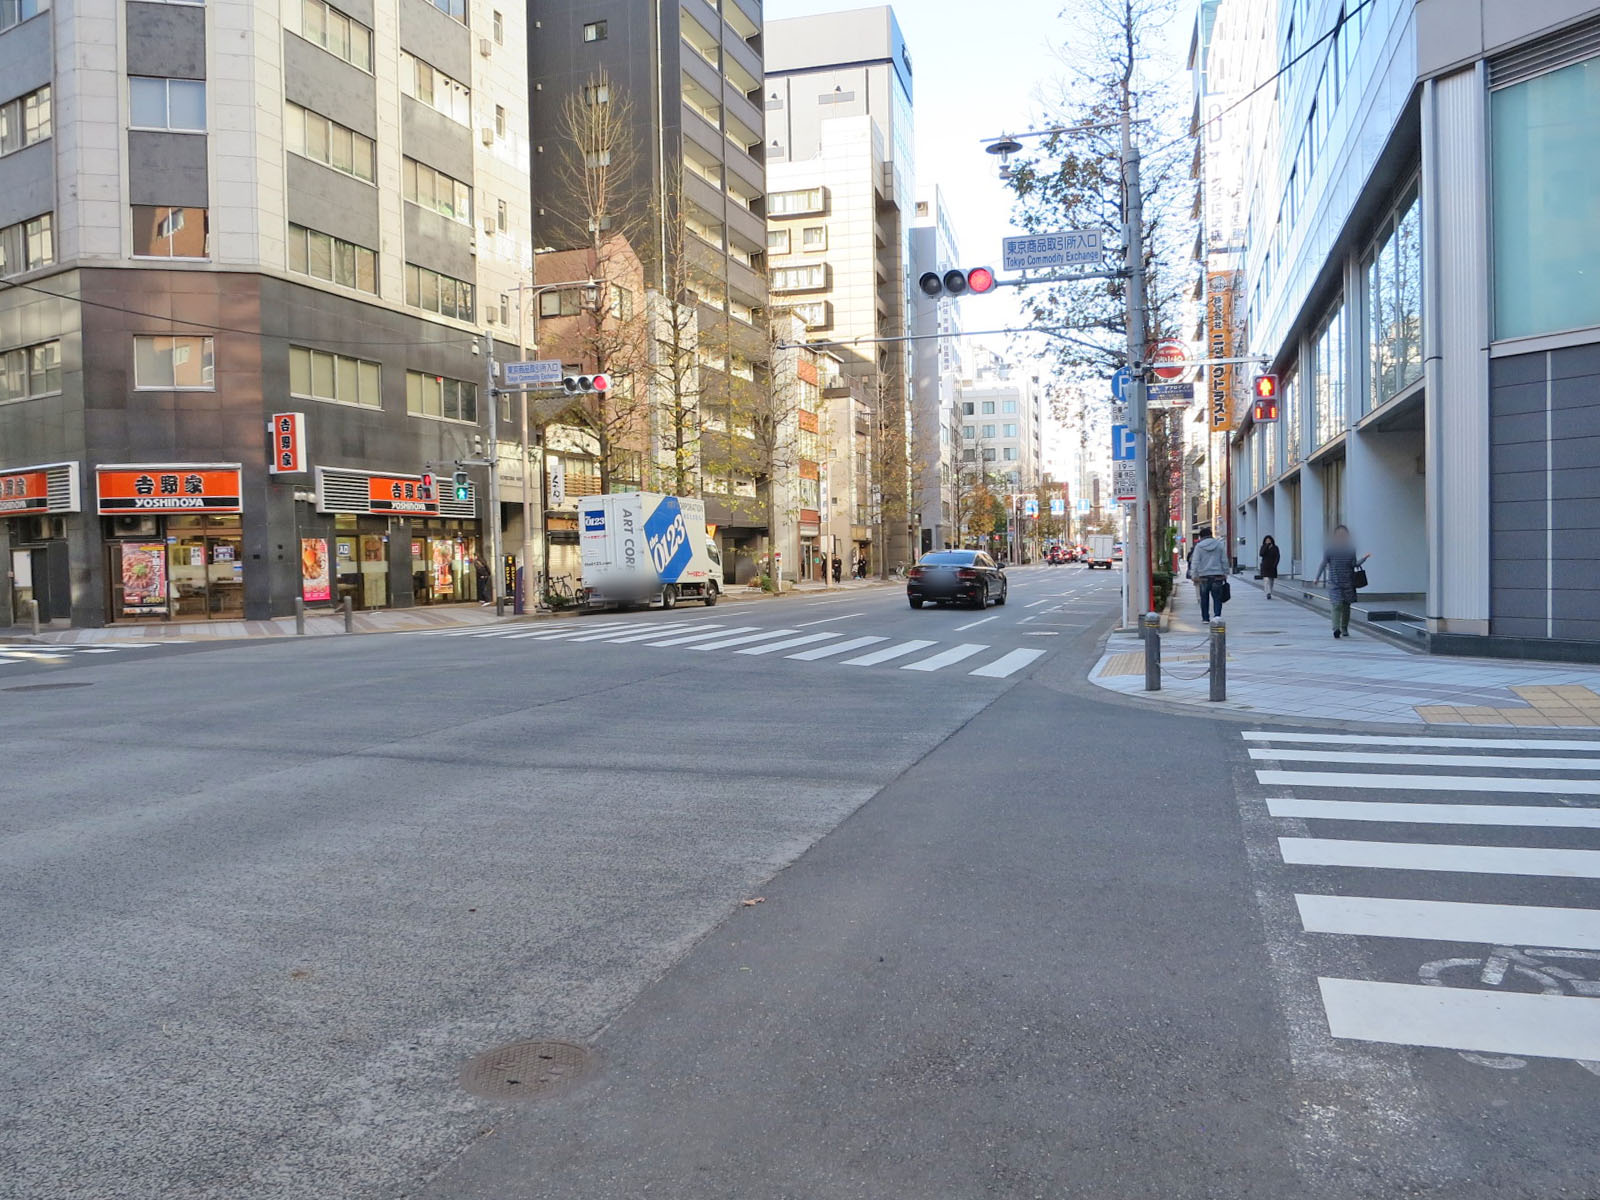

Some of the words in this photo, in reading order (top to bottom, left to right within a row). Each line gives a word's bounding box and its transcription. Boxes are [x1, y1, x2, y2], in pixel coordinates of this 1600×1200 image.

[1007, 234, 1097, 255] 東京商品取引所入口
[1006, 257, 1026, 267] Tokyo
[1027, 252, 1064, 265] Commodity
[1066, 250, 1099, 261] Exchange
[135, 498, 205, 507] YOSHINOYA
[391, 501, 426, 511] YOSHINOYA
[586, 517, 605, 526] 0123
[622, 508, 634, 534] ART
[653, 514, 686, 574] 0123
